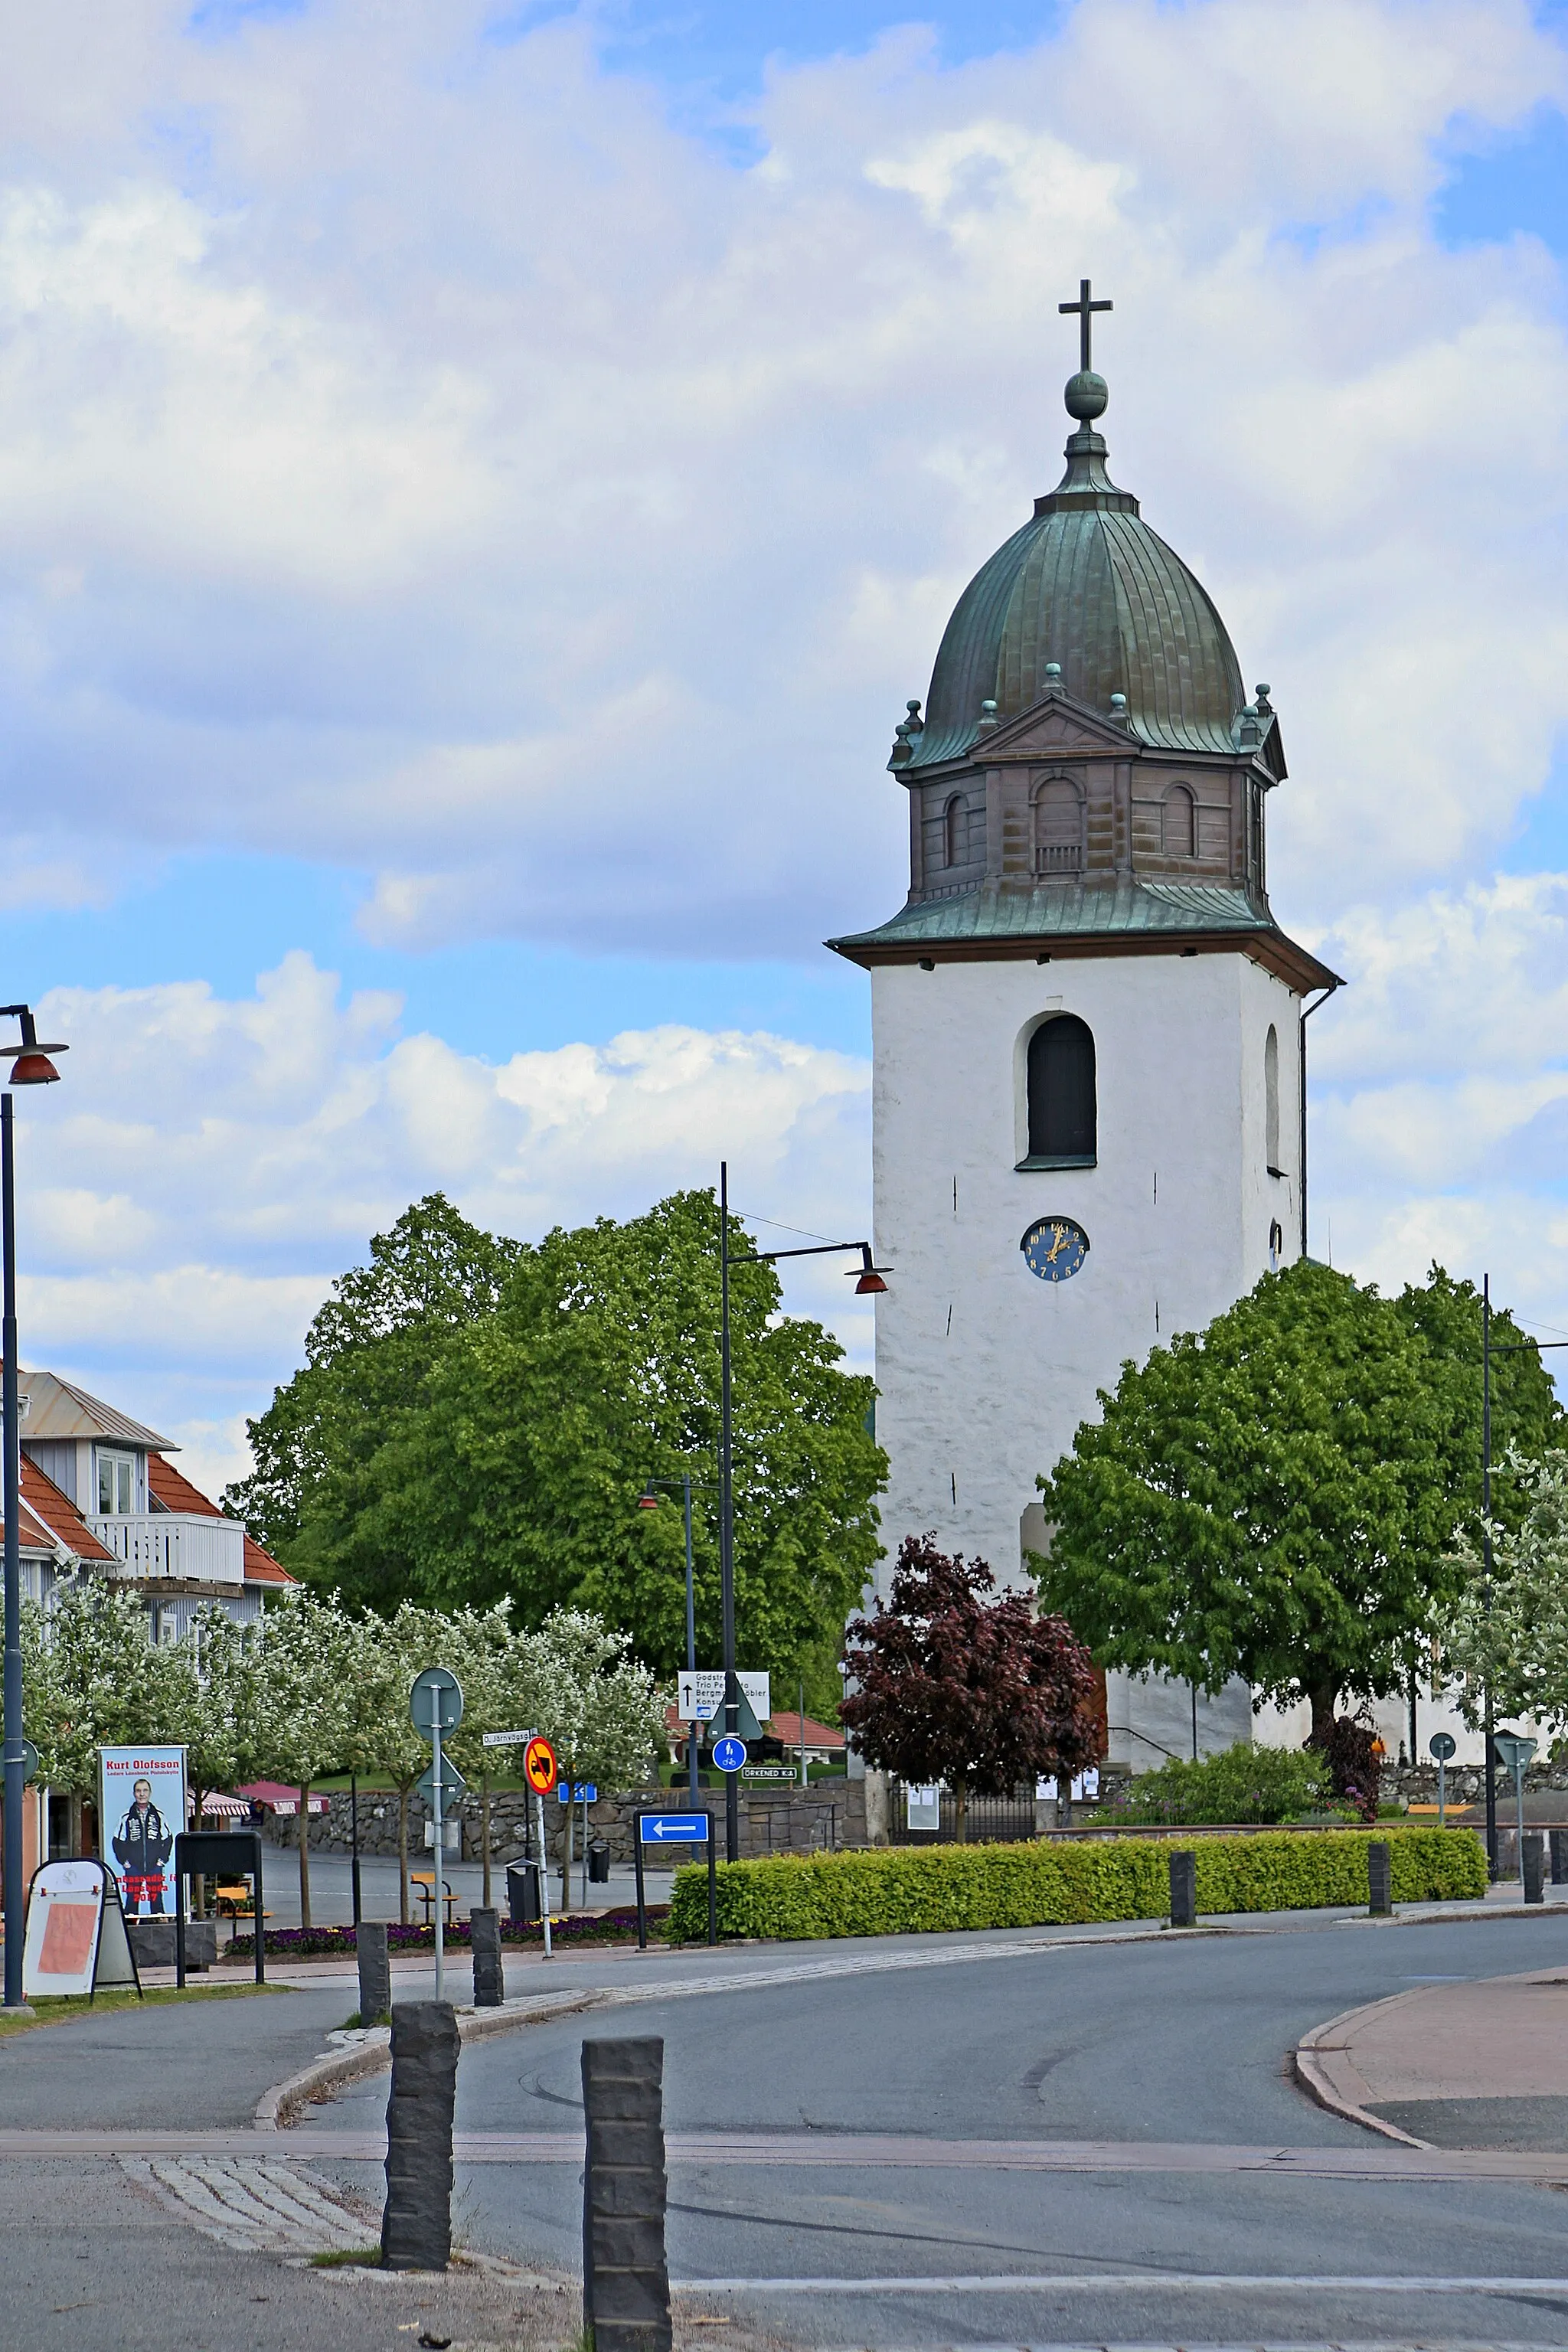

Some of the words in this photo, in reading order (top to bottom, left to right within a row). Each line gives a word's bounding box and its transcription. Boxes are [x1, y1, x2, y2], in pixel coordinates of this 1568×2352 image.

[1039, 1226, 1045, 1236] 11
[1066, 1225, 1069, 1234] 1
[1030, 1234, 1039, 1245] 10
[1073, 1232, 1079, 1242] 2
[1078, 1245, 1085, 1256] 3
[1030, 1259, 1037, 1269] 8
[1073, 1258, 1080, 1268] 4
[1040, 1266, 1047, 1277] 7
[1052, 1271, 1058, 1280] 6
[1065, 1266, 1071, 1276] 5
[106, 1761, 129, 1769] Kurt
[133, 1760, 179, 1769] Olofsson
[133, 1893, 158, 1902] 2017
